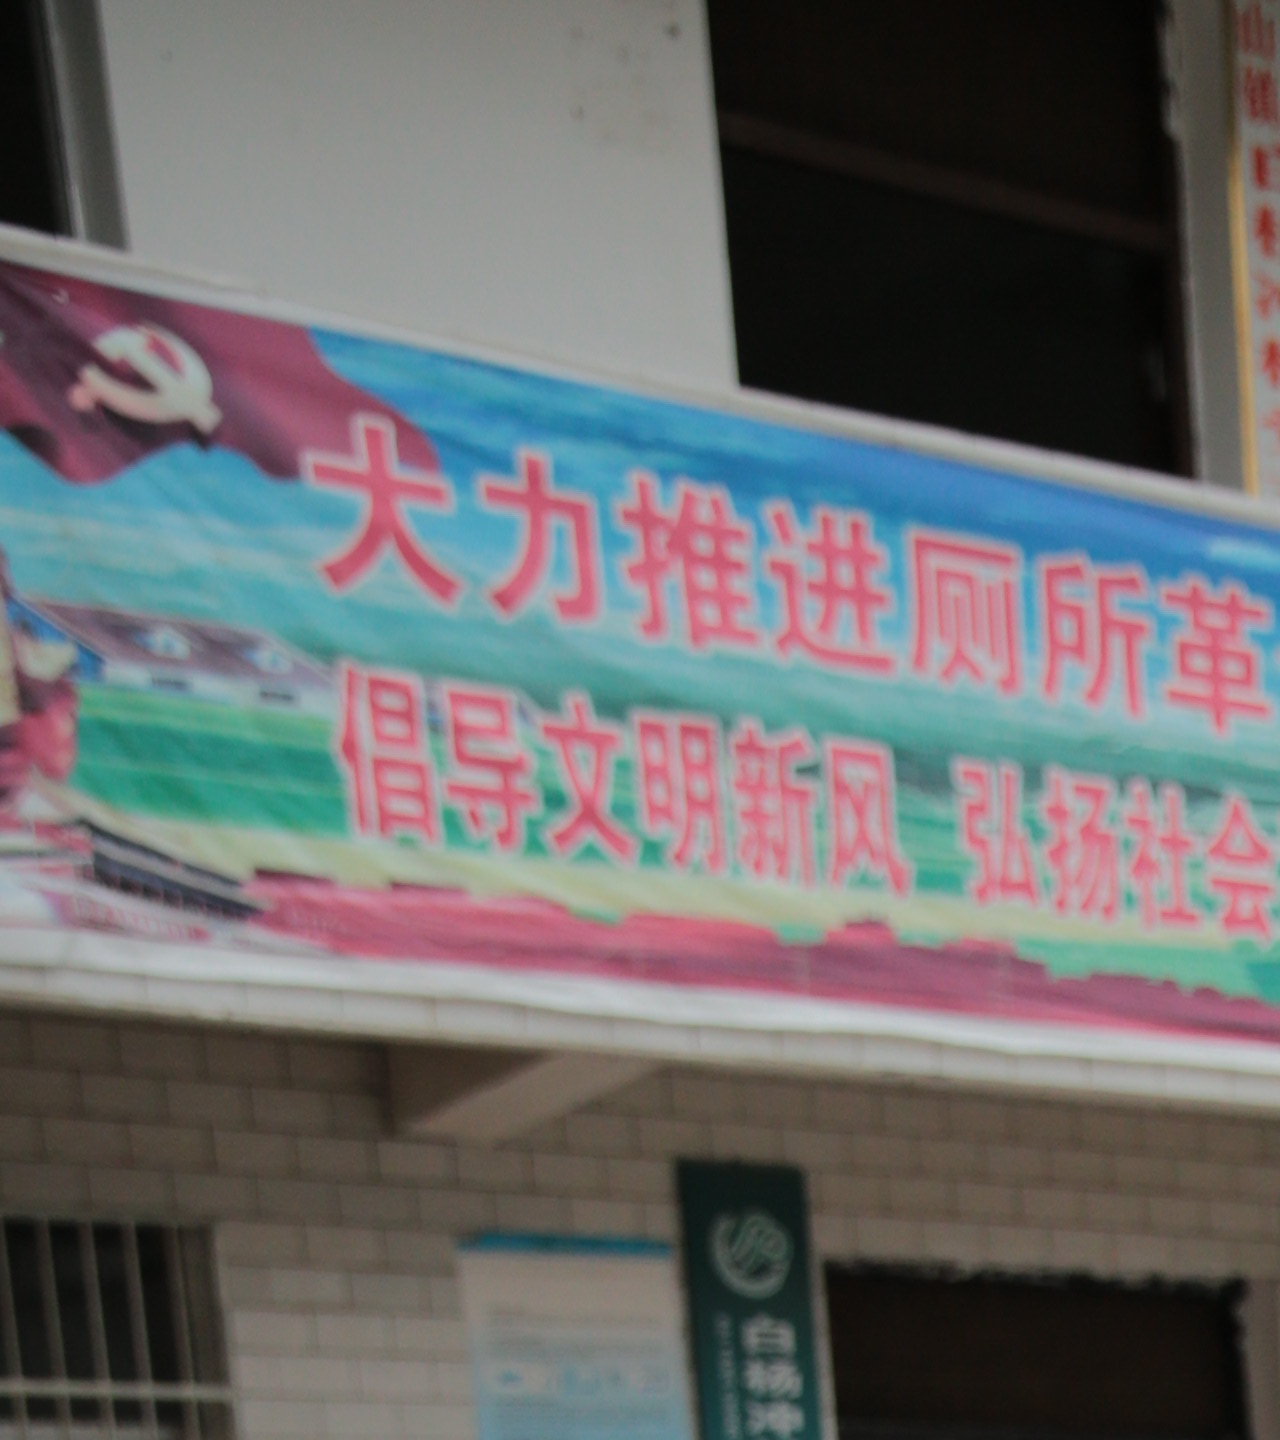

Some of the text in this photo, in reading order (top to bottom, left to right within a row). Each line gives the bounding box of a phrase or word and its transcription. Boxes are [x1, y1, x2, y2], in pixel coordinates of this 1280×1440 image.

[335, 659, 911, 898] 倡导文明新风
